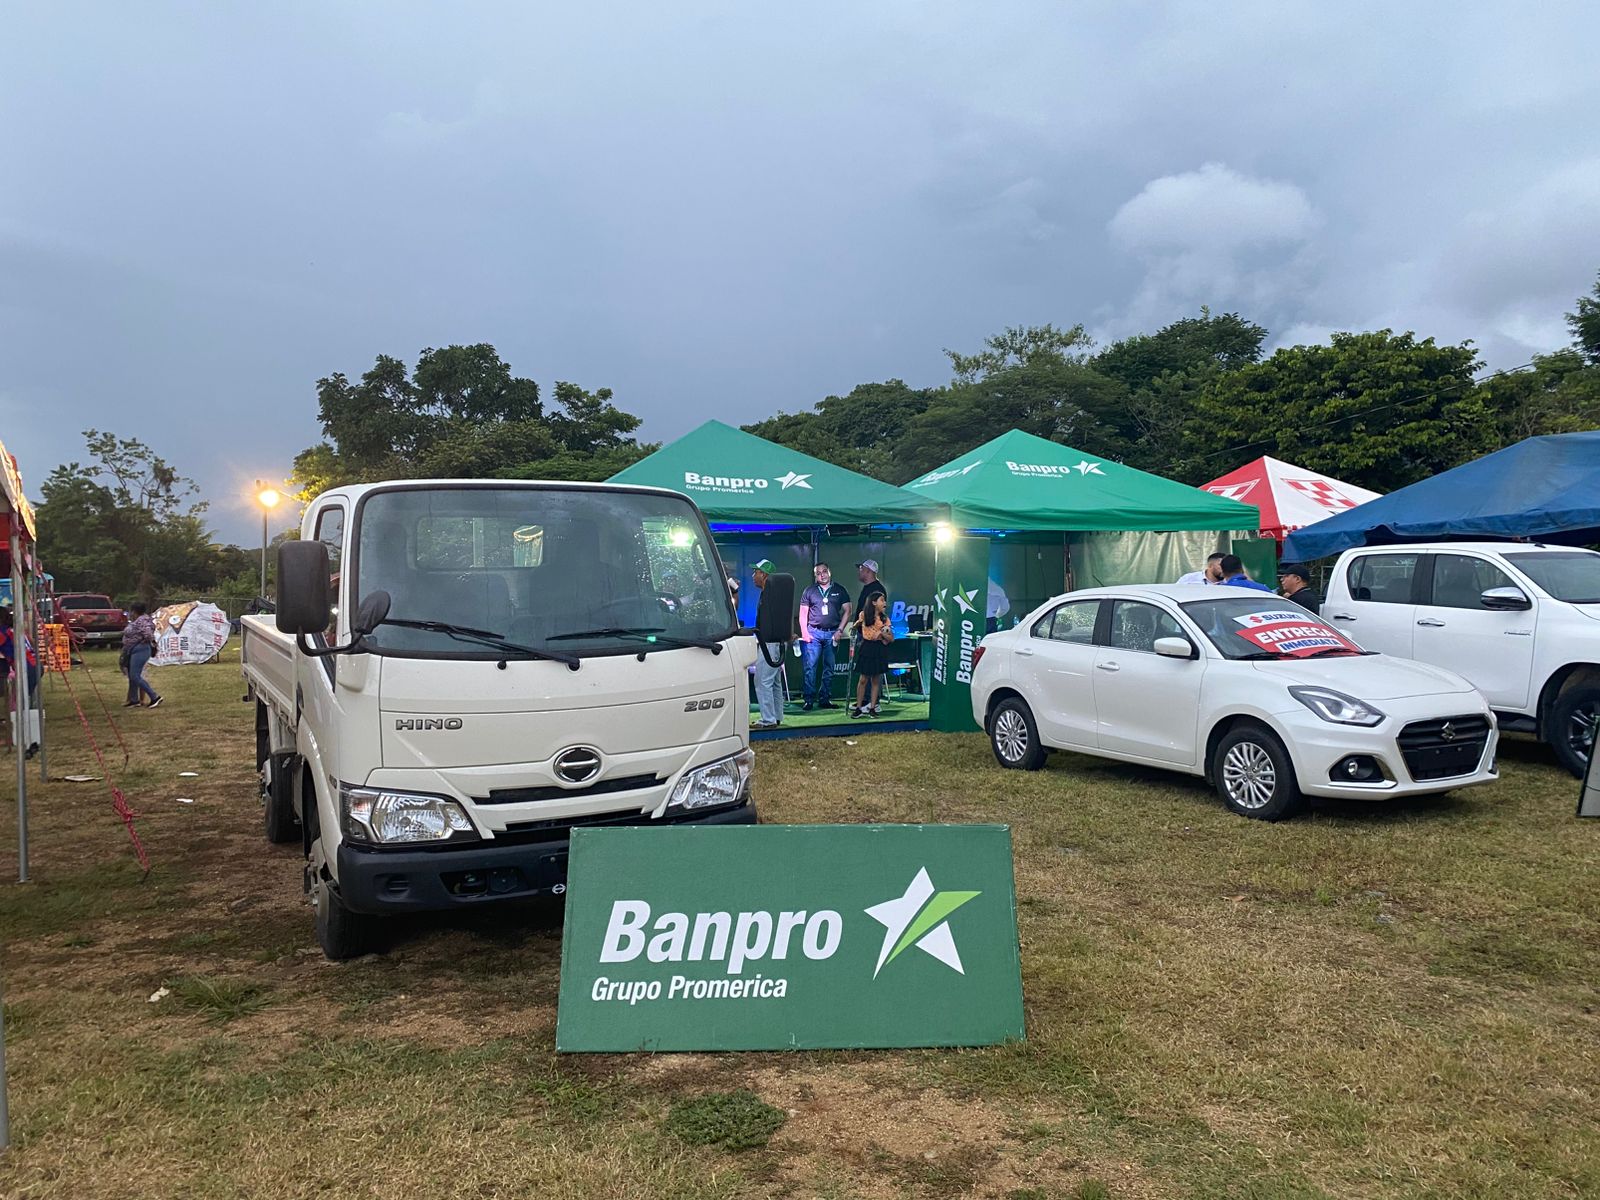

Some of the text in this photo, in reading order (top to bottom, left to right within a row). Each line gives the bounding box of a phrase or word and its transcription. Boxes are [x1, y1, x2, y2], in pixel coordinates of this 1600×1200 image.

[1005, 460, 1071, 475] Banpro
[684, 471, 768, 489] Banpro
[1261, 612, 1302, 621] SUZUKI
[1254, 626, 1338, 644] ENTREGA
[934, 619, 945, 683] Banpro
[956, 620, 976, 684] Banpro
[1280, 639, 1341, 650] INMEDIATA
[684, 698, 725, 712] 200
[395, 718, 463, 730] HINO
[599, 900, 843, 975] Banpro
[591, 974, 788, 1006] Grupo Promerica
